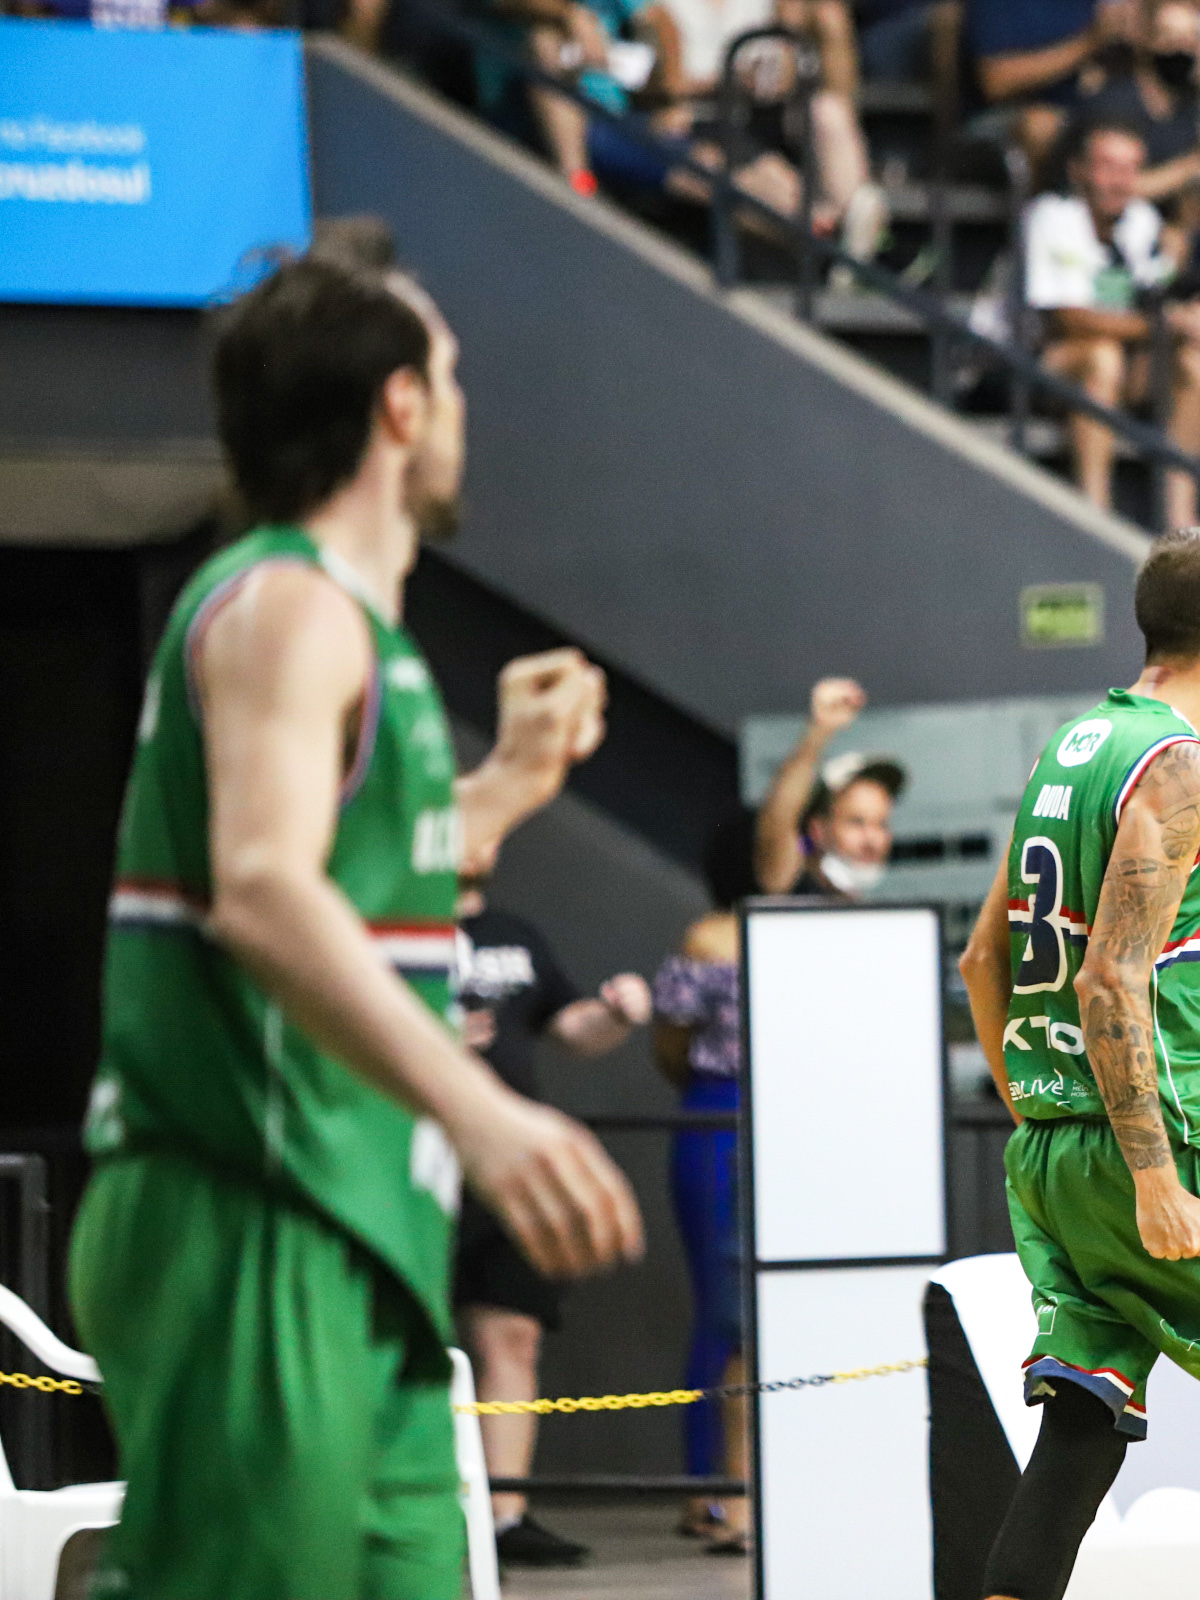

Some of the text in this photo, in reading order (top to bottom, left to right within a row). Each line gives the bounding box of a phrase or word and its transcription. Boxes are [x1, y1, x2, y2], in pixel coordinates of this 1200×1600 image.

[1031, 784, 1073, 820] DUDA
[1013, 835, 1068, 994] 3
[1002, 1015, 1085, 1056] KTO
